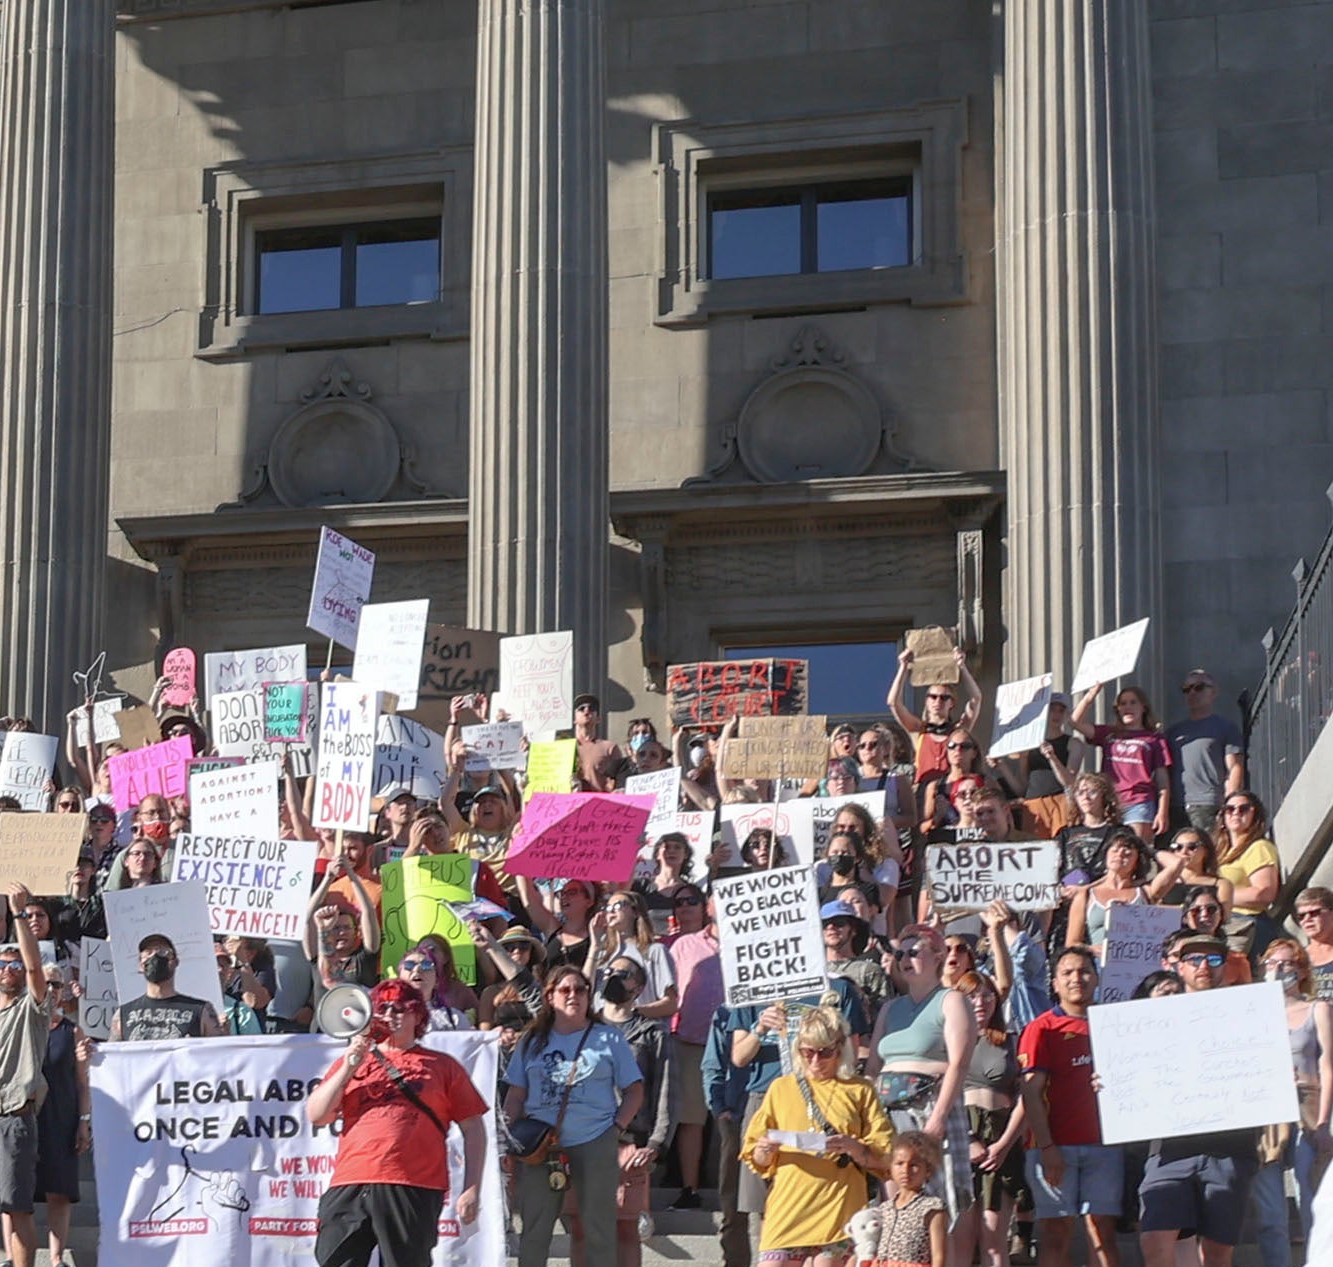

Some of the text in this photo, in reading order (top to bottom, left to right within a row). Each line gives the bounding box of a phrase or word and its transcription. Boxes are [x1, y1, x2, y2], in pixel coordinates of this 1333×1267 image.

[219, 653, 299, 678] MY BODY
[669, 659, 802, 692] ABORT
[265, 686, 285, 698] NOT
[326, 685, 337, 708] I
[266, 700, 292, 709] YOUR
[690, 689, 787, 722] COURT
[285, 726, 303, 736] YOU
[324, 709, 351, 732] AM
[323, 733, 373, 757] the BOSS
[201, 771, 257, 789] AGAINST
[319, 764, 331, 779] of
[341, 761, 364, 783] MY
[209, 808, 258, 824] HAVE A
[320, 784, 366, 825] BODY
[180, 835, 288, 863] RESPECT OUR
[935, 846, 1043, 871] ABORT
[176, 858, 287, 891] EXISTENCE
[717, 868, 810, 900] WE WON'T
[937, 869, 994, 883] THE
[246, 888, 274, 909] OUR
[725, 887, 807, 918] GO BACK
[932, 881, 1062, 904] SUPREME COURT
[730, 907, 807, 936] WE WILL
[735, 935, 803, 963] FIGHT
[736, 955, 808, 984] BACK!
[155, 1077, 321, 1106] LEGAL ABO
[133, 1114, 300, 1144] ONCE AND
[280, 1157, 303, 1174] WE
[268, 1180, 324, 1199] WE WILL
[131, 1220, 317, 1236] PSLWEB.ORG PARTY FOR
